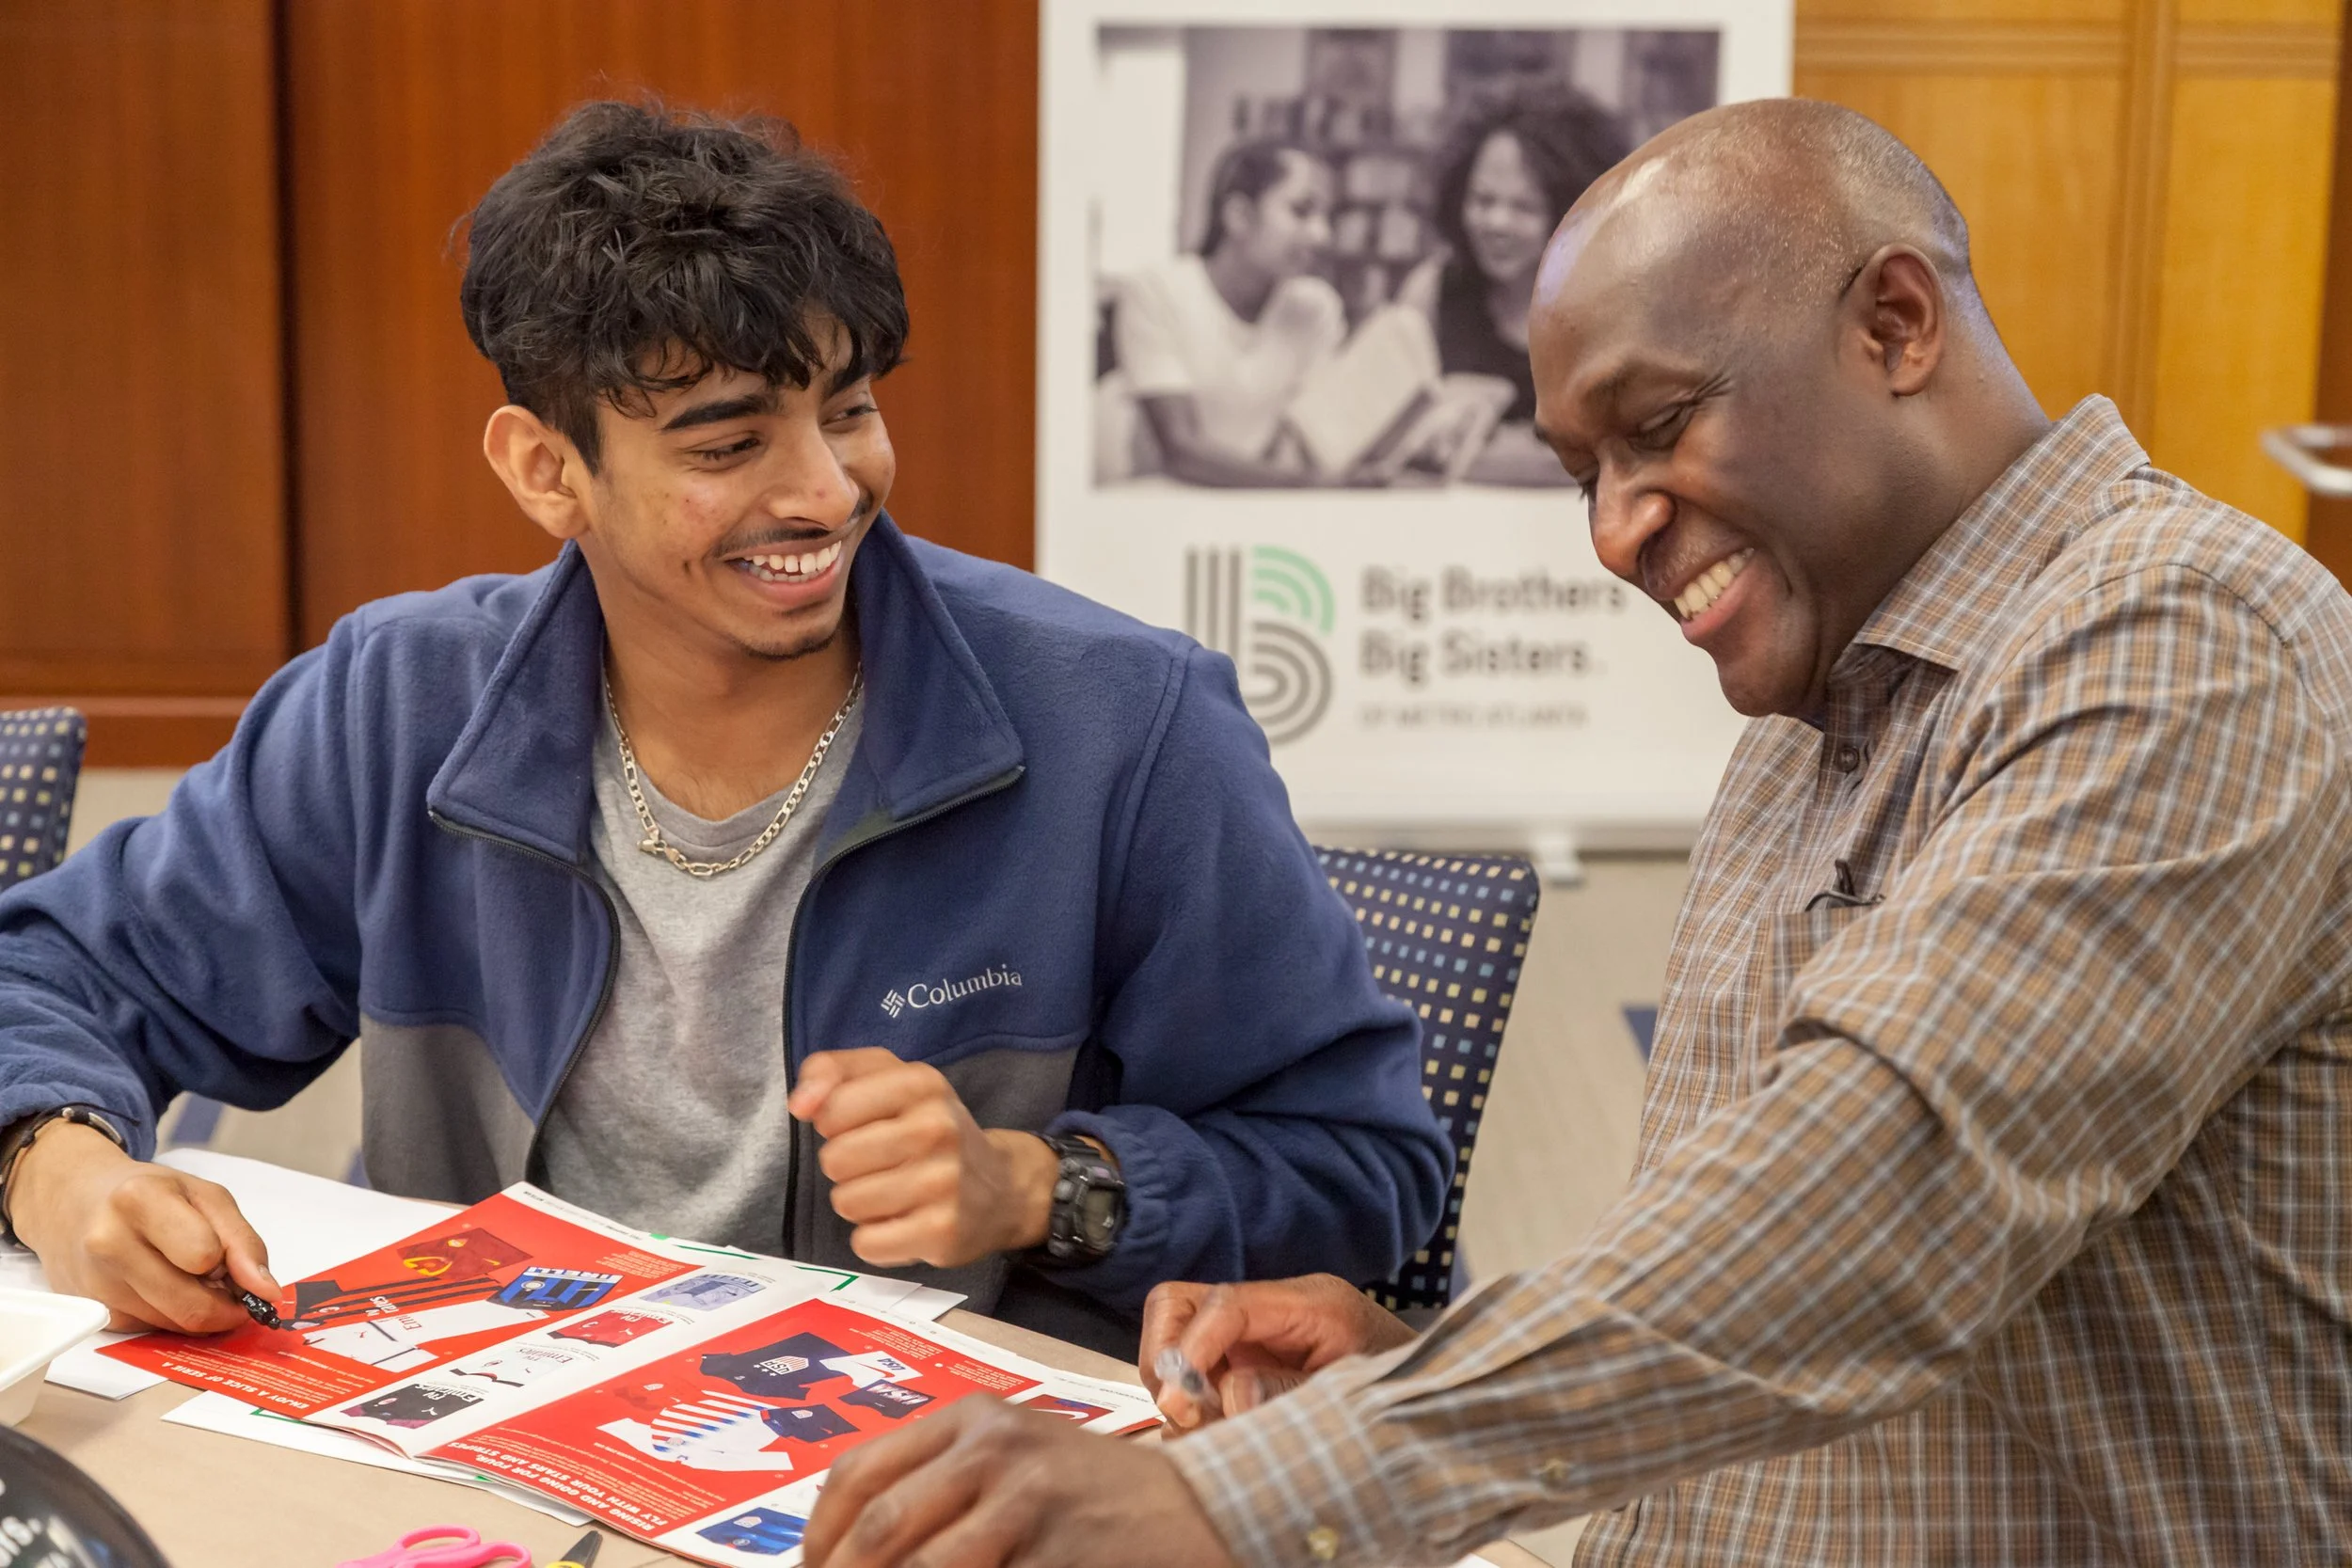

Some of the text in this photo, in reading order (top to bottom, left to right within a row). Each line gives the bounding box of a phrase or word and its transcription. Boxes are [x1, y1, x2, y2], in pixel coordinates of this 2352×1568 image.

[1362, 565, 1627, 623] Big Brothers
[1360, 629, 1427, 689] Big
[907, 963, 1022, 1008] Columbia
[171, 1365, 207, 1379] SERIE
[205, 1374, 225, 1383] OF
[222, 1378, 259, 1393] SLICE
[269, 1394, 310, 1410] ENJOY
[511, 1466, 540, 1480] FOR
[447, 1442, 668, 1526] FLY WITH YOUR STARS AND STRIPES
[538, 1477, 580, 1497] GOING
[580, 1494, 611, 1510] AND
[609, 1508, 655, 1531] RISING
